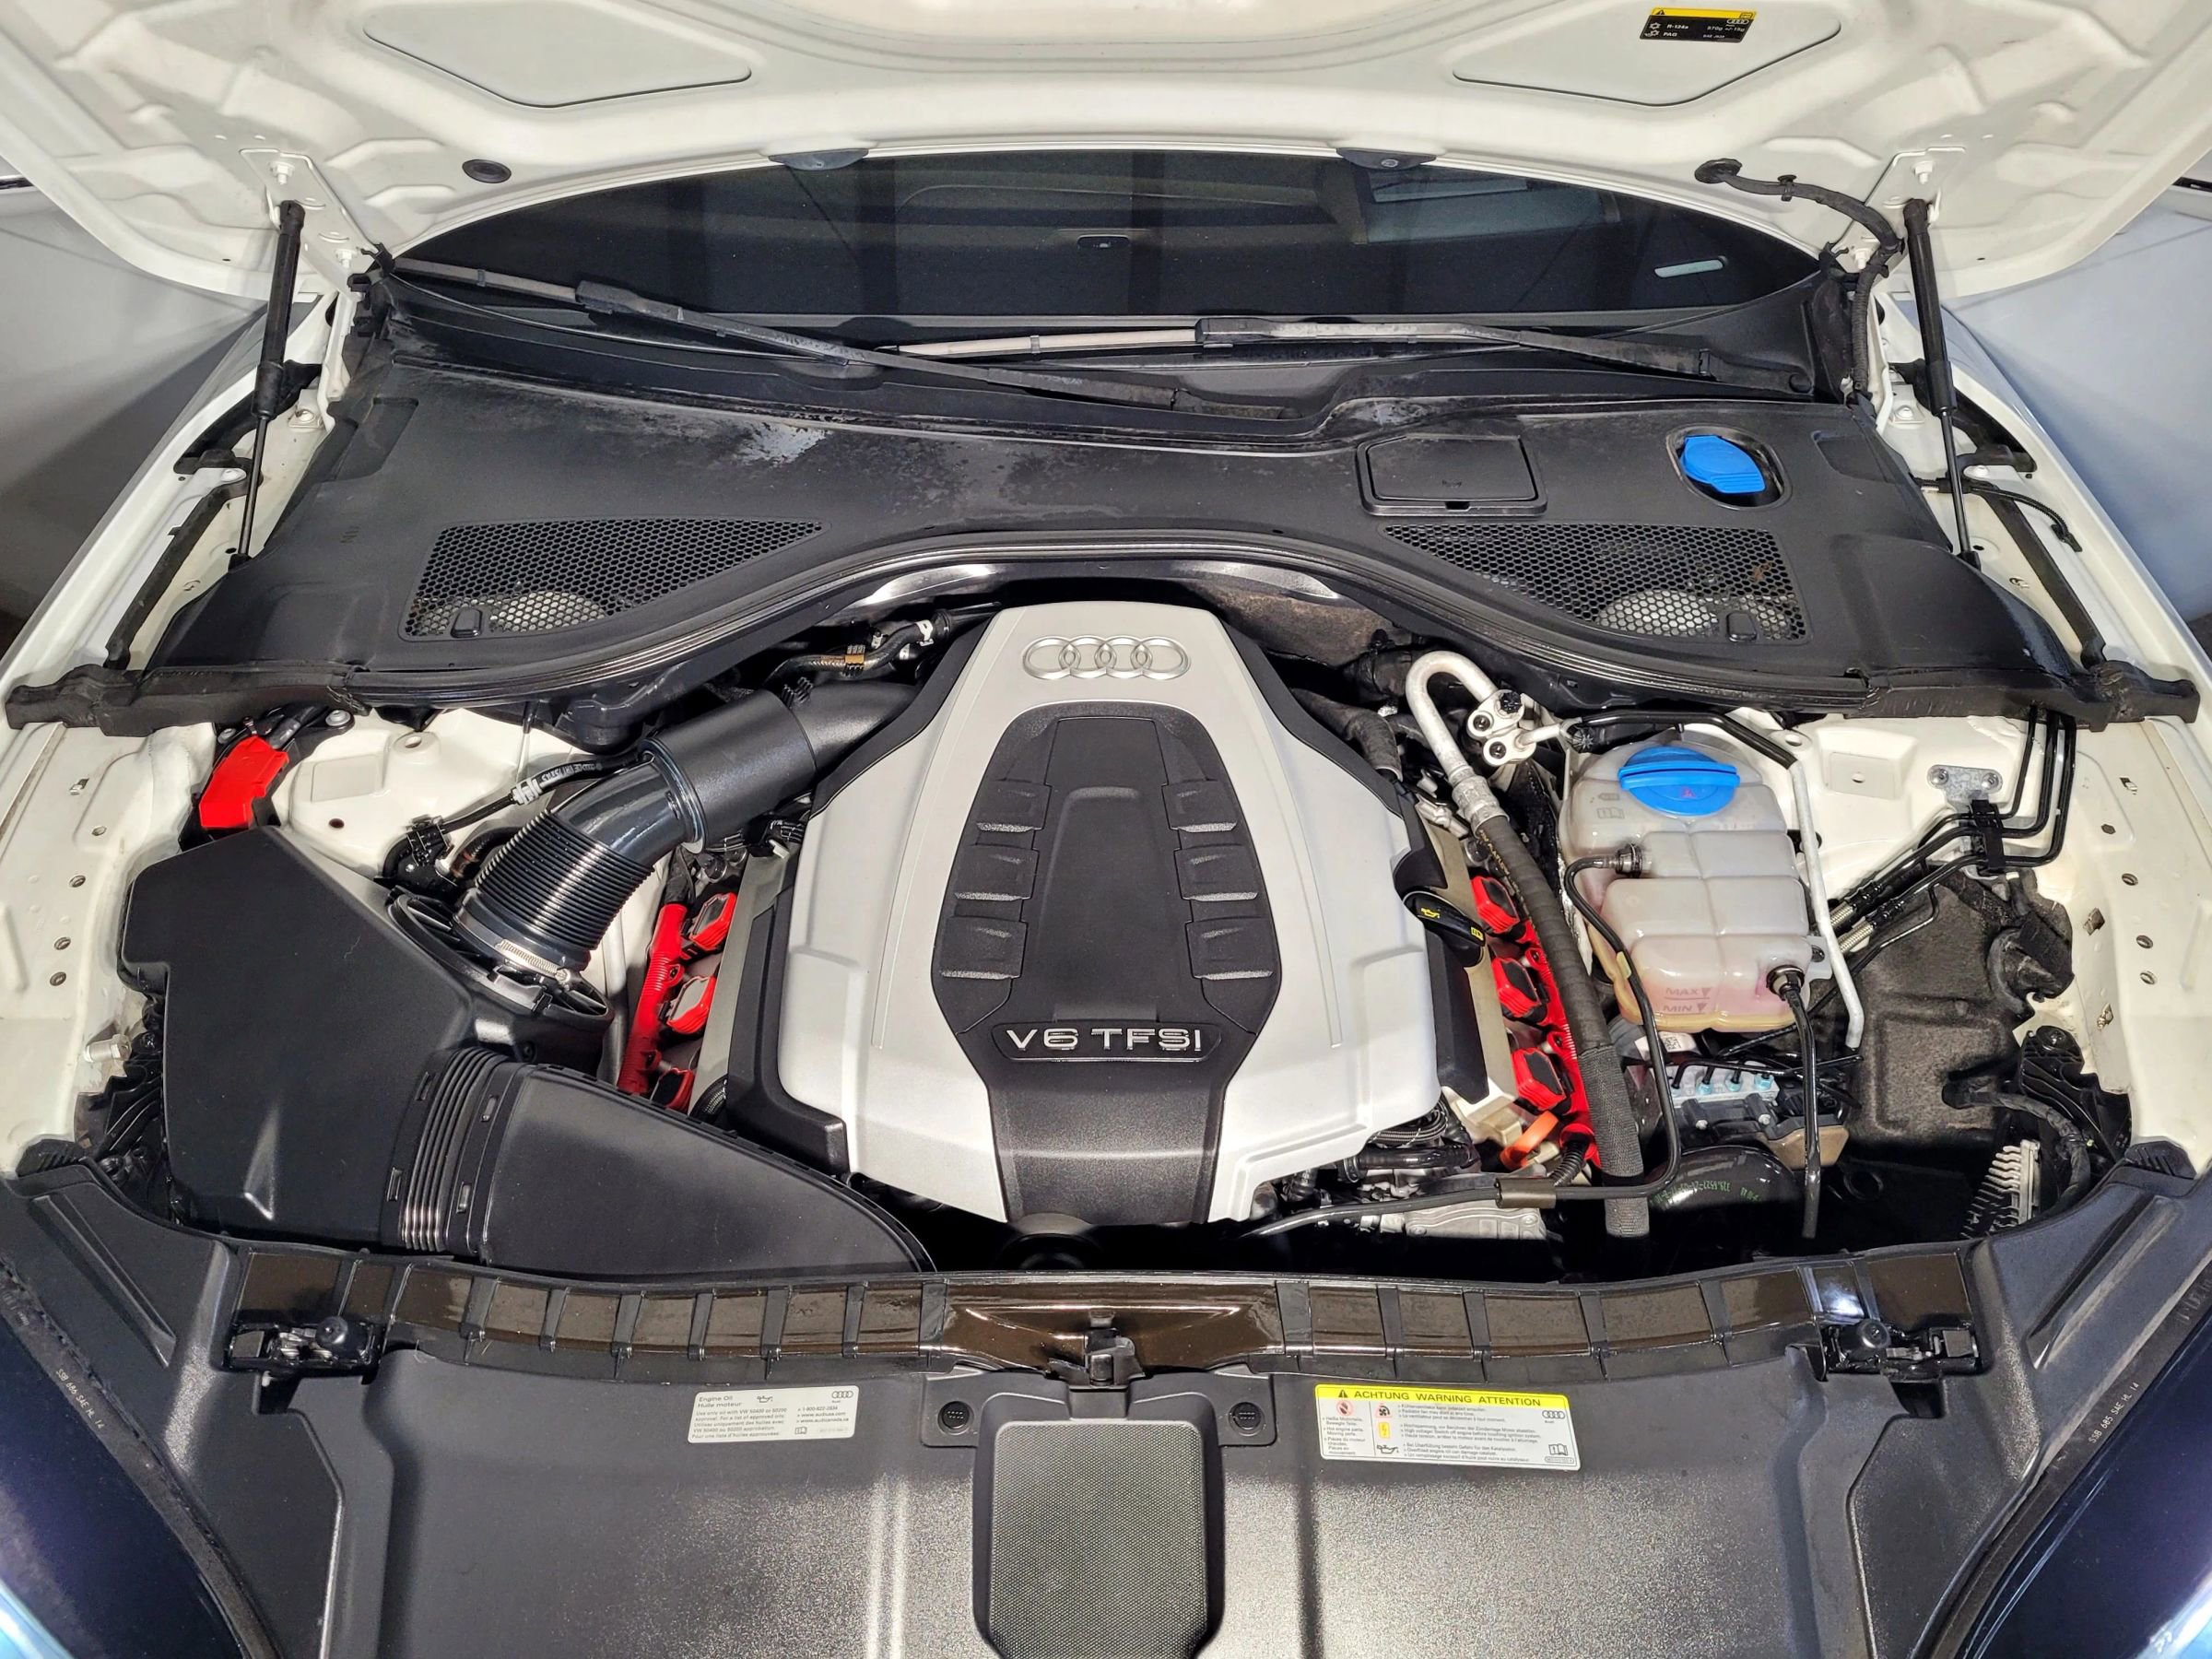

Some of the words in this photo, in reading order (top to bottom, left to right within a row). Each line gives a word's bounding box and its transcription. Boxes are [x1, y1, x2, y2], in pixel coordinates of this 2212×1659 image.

[1665, 987, 1699, 995] MAX
[1663, 1005, 1693, 1013] MIN
[1006, 1029, 1079, 1051] V6
[1091, 1028, 1202, 1052] TFSI
[1353, 1390, 1410, 1401] ACHTUNG
[1415, 1393, 1472, 1404] WARNING
[1478, 1395, 1541, 1406] ATTENTION
